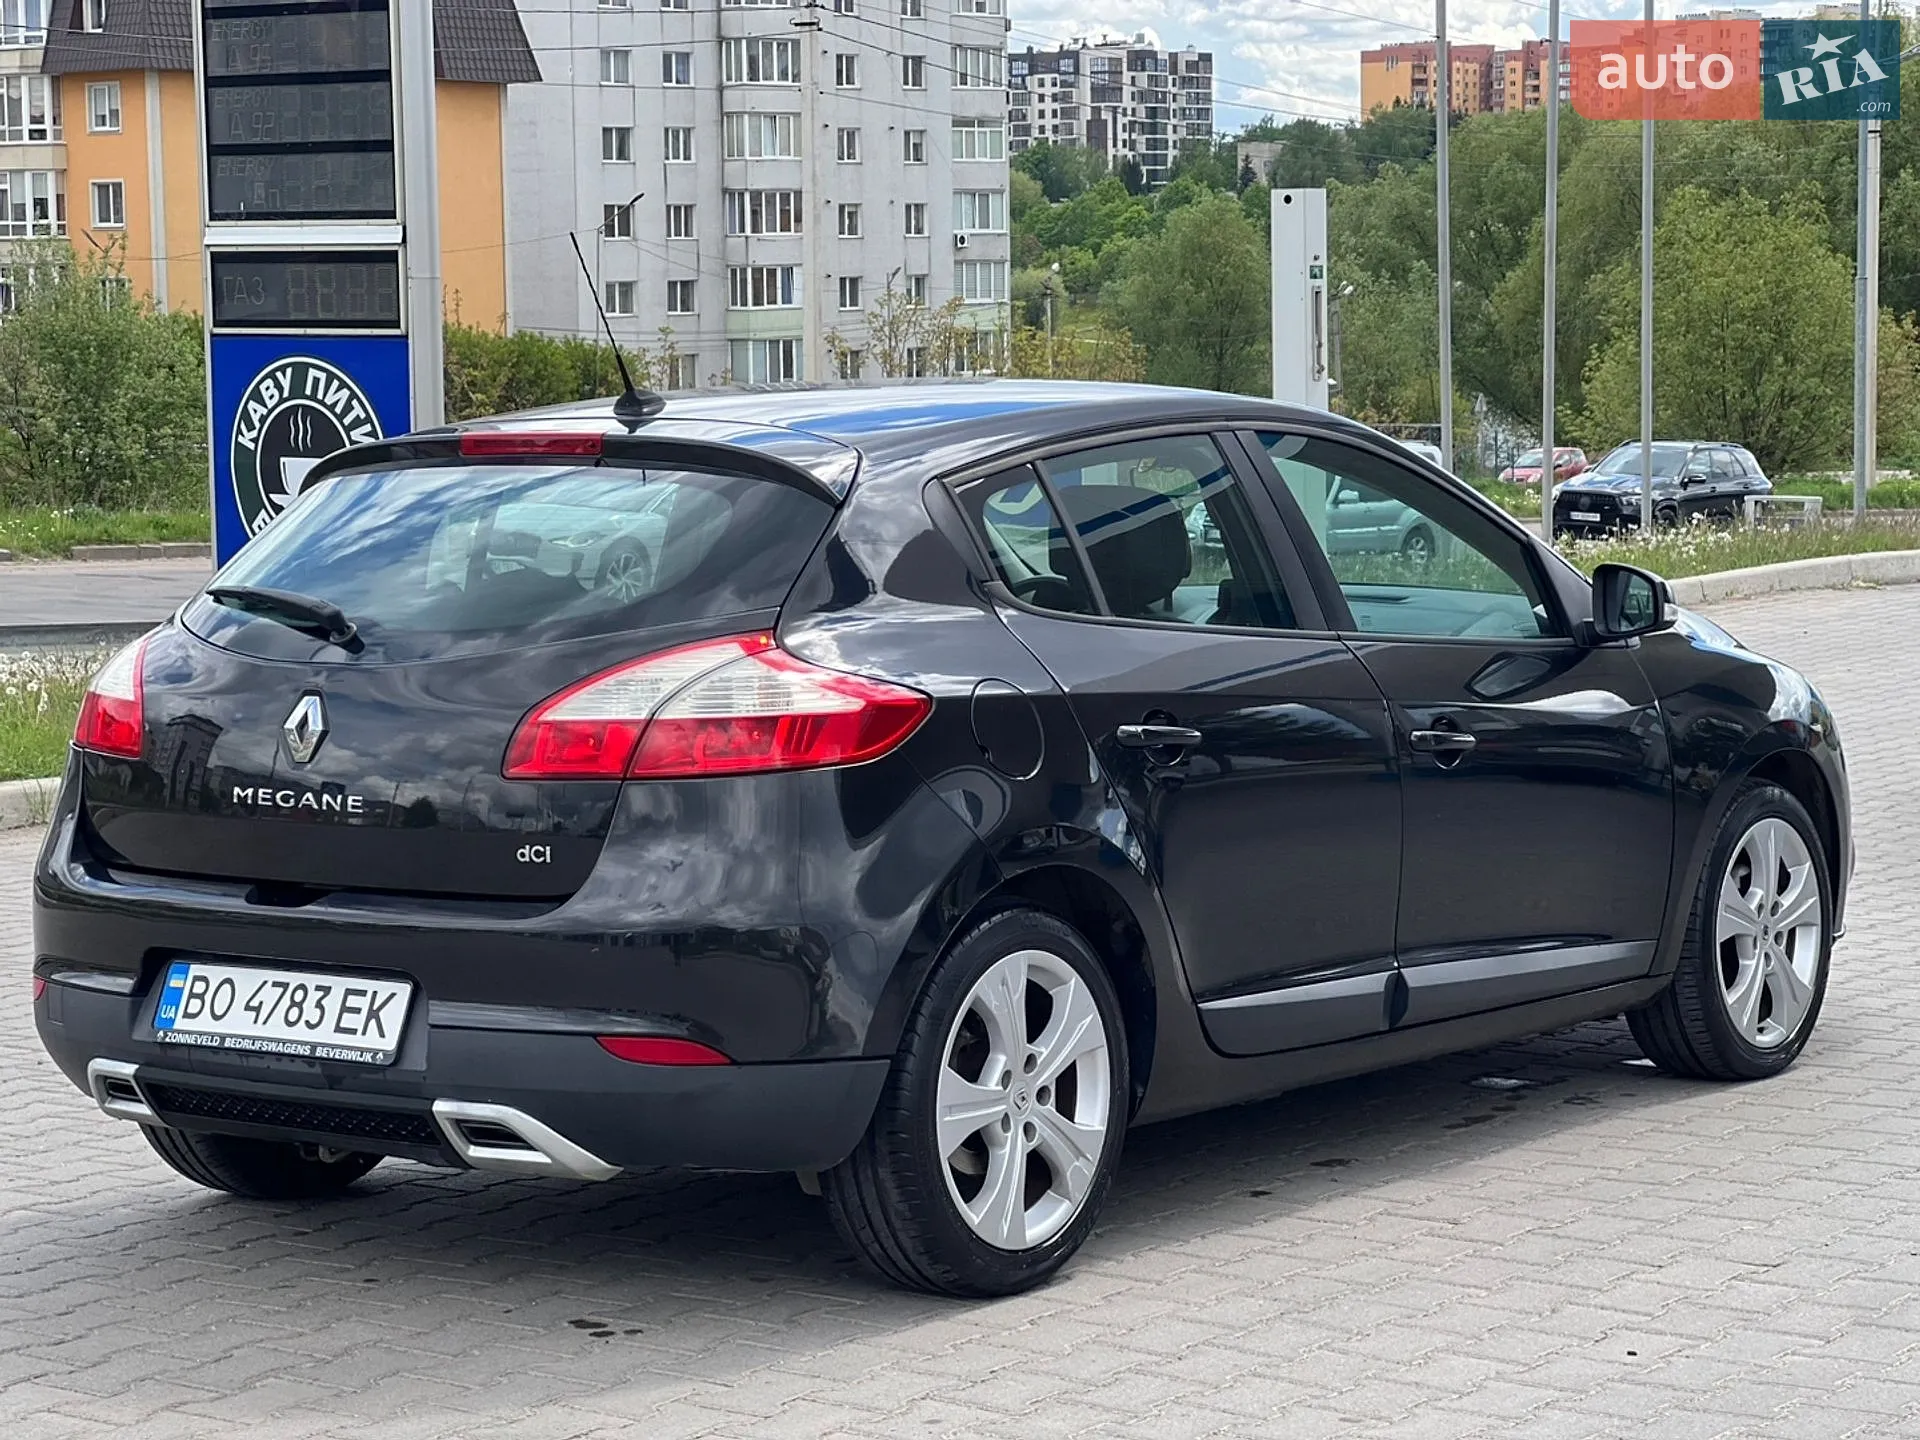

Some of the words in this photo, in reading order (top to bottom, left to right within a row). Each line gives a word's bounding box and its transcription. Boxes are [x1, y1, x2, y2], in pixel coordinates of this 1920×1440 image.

[223, 276, 265, 305] ГАЗ
[237, 366, 293, 451] КАВУ
[232, 786, 364, 813] MEGANE
[160, 1004, 176, 1020] UA
[182, 974, 236, 1022] BO
[243, 980, 333, 1030] 4783
[333, 987, 398, 1039] EK
[165, 1032, 220, 1046] ZONNEVELD
[224, 1037, 311, 1055] BEDRIJFSWAGENS
[315, 1046, 373, 1062] BEVERWIJK
